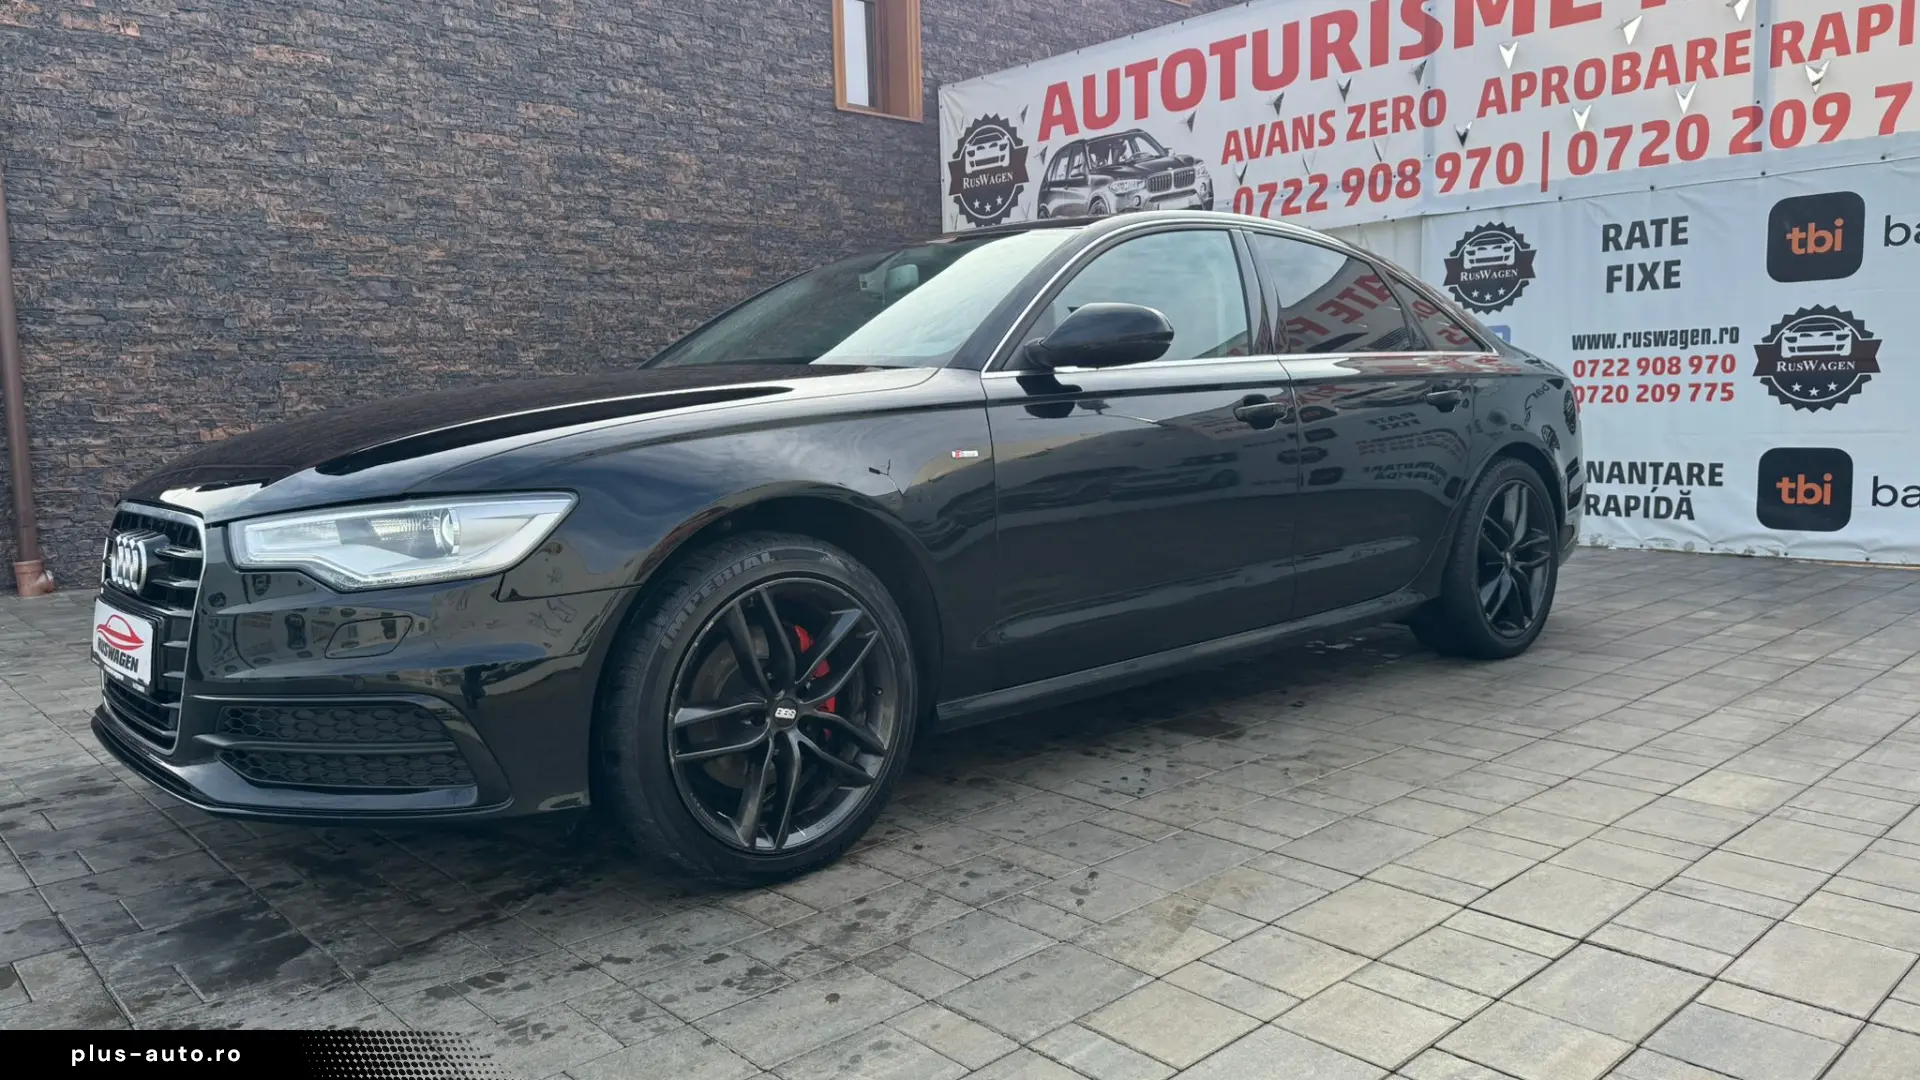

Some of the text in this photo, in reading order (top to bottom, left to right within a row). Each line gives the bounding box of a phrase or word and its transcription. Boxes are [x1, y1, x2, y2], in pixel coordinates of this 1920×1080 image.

[1221, 0, 1915, 165] AVANS ZERO APROBARE RAPI
[1232, 172, 1328, 219] 0722
[1341, 158, 1421, 207] 908
[1435, 142, 1524, 194] 970
[1567, 114, 1710, 176] 0720
[1728, 91, 1852, 156] 209
[1602, 215, 1690, 253] RATE
[1786, 217, 1845, 256] tbi
[1605, 259, 1682, 294] FIXE
[1572, 326, 1740, 351] www.ruswagen.ro
[1573, 353, 1736, 378] 0722 908 970
[1574, 384, 1629, 404] 0720
[1635, 383, 1681, 403] 209
[1688, 382, 1735, 402] 775
[1776, 472, 1833, 506] tbi
[660, 551, 776, 649] IMPERIAL
[775, 707, 797, 719] BBS
